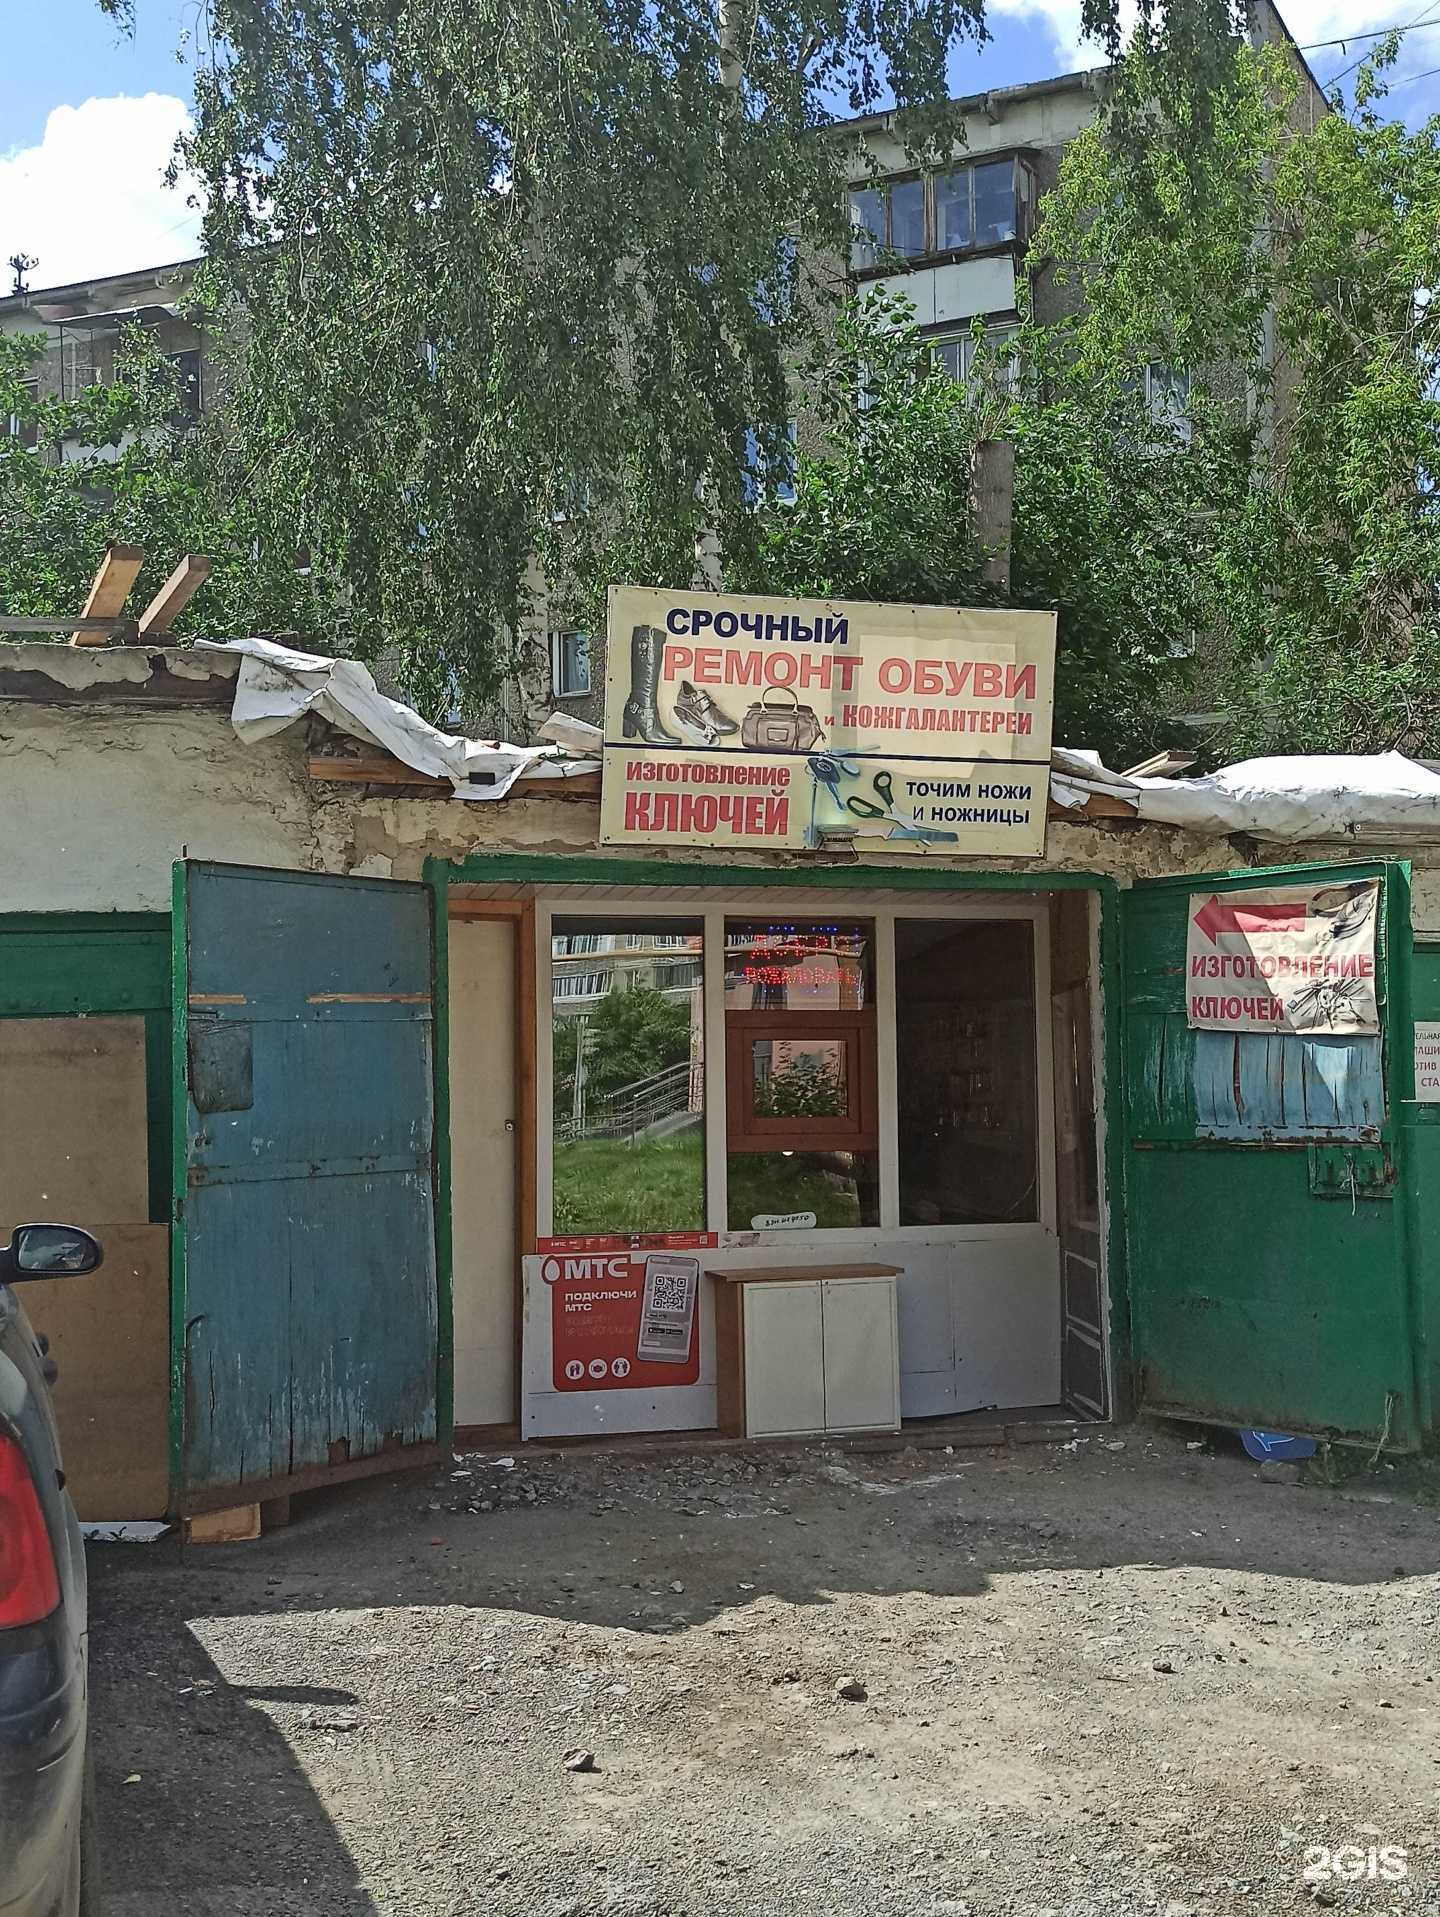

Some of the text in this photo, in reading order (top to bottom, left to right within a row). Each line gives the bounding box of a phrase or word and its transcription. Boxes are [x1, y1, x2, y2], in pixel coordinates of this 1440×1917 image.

[666, 608, 849, 645] СРОЧНЫЙ
[663, 646, 1037, 700] РЕМОНТ ОБУВИ
[906, 782, 1032, 800] ТОЧИМ НОЖИ
[624, 789, 790, 836] КЛЮЧЕЙ
[931, 806, 1030, 826] НОЖНИЦЫ
[1191, 954, 1375, 978] ИЗГОТОВЛЕНИЕ
[1191, 993, 1285, 1021] КЛЮЧЕЙ
[564, 1257, 629, 1280] МТС
[565, 1290, 637, 1302] ПОДКЛЮЧИ
[565, 1303, 593, 1312] МТС
